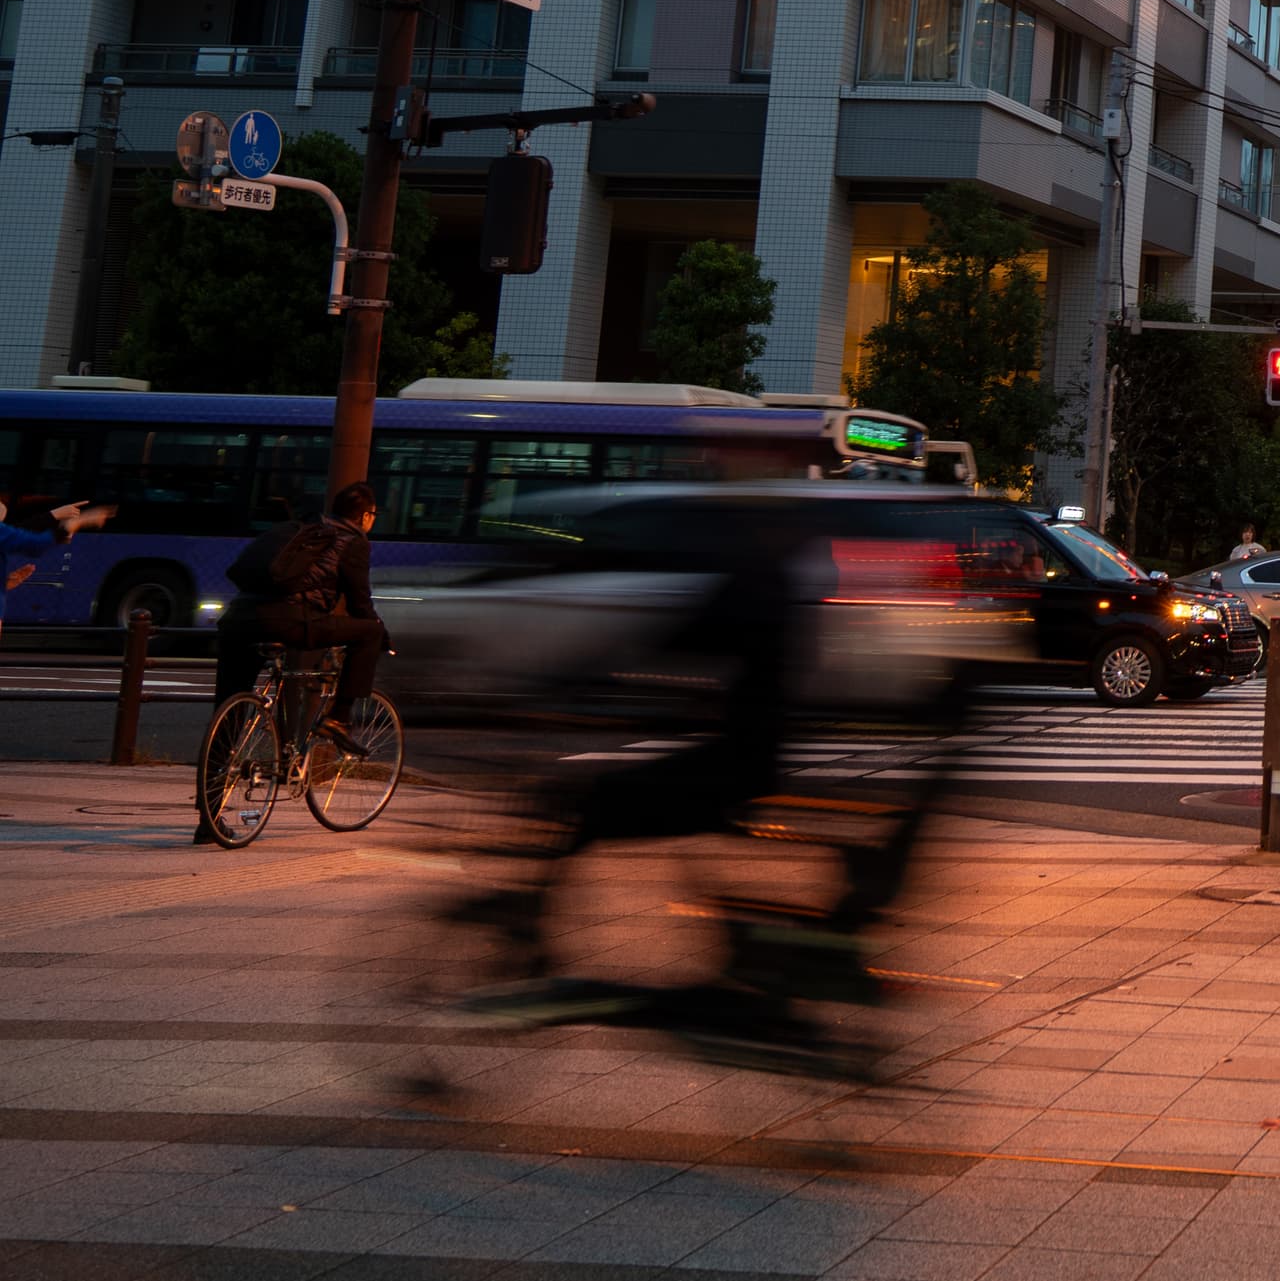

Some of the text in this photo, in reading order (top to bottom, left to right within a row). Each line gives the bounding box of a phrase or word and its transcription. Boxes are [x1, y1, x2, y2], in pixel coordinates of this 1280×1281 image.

[224, 184, 272, 205] 歩行者優先
